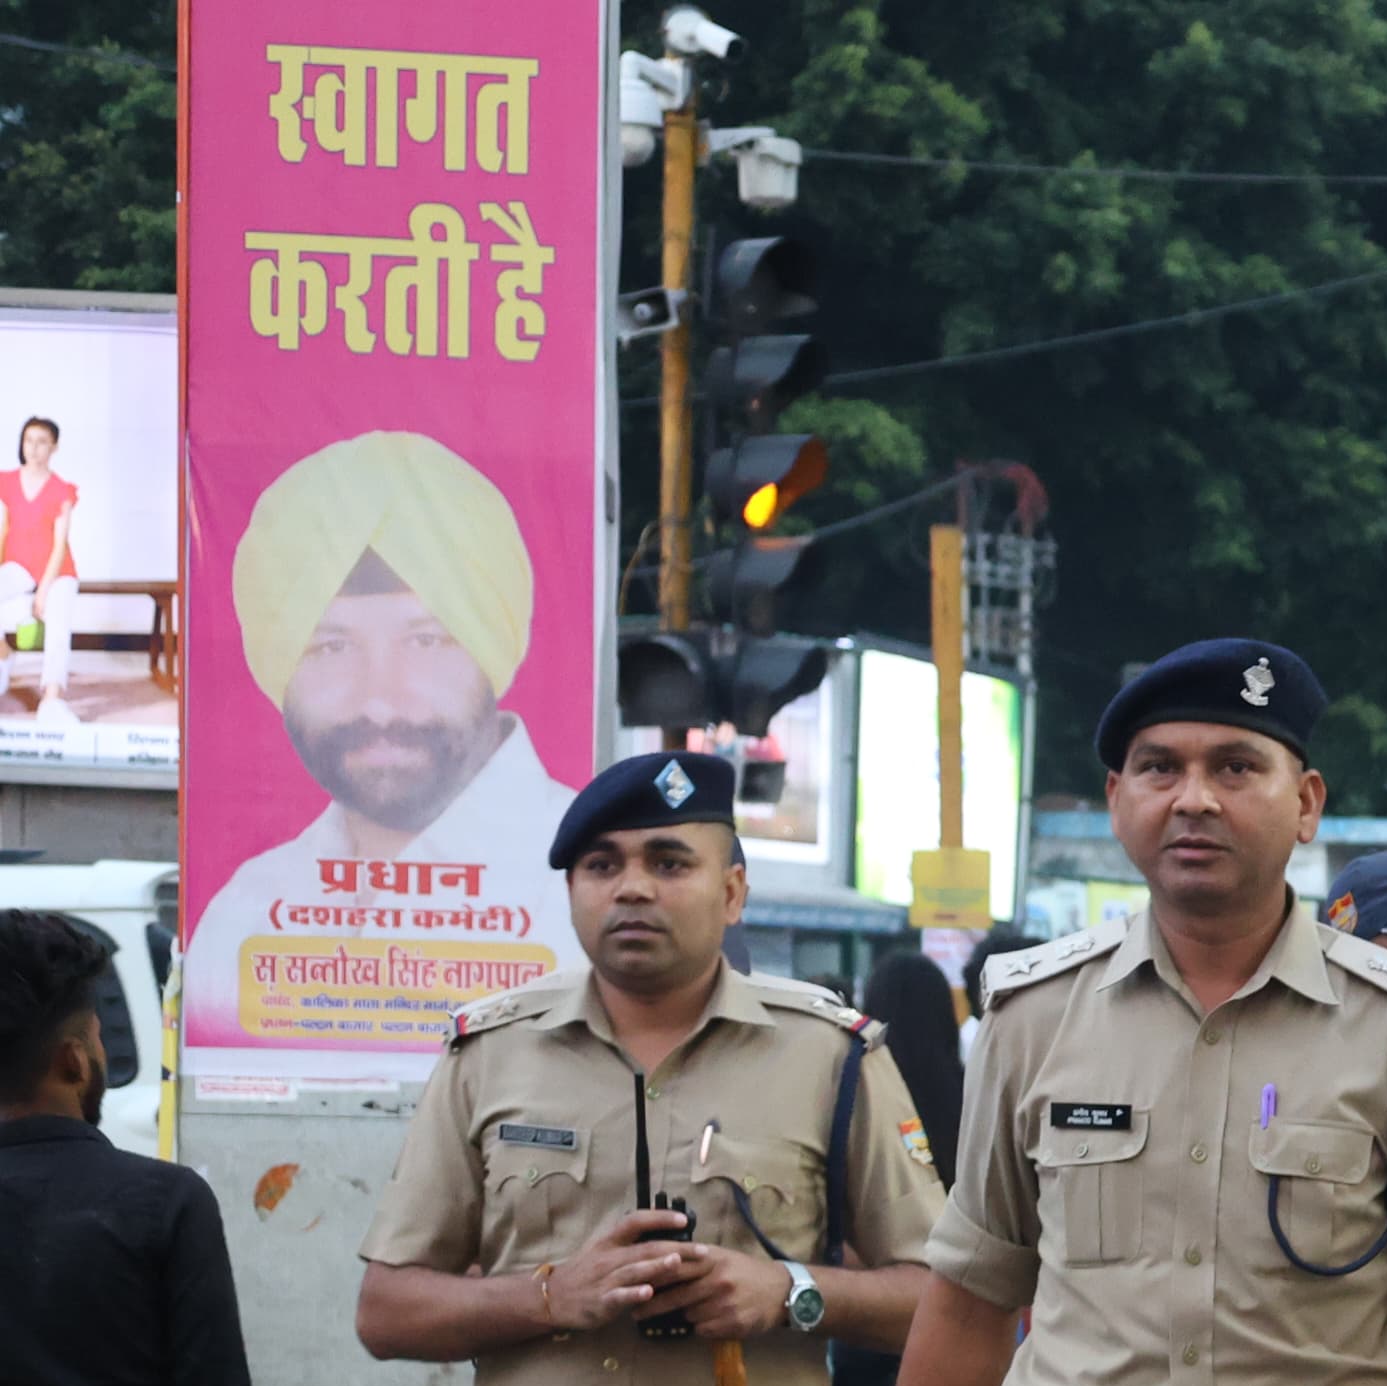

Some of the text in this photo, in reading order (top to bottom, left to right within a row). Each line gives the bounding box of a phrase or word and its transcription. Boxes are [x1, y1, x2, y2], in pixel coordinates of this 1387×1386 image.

[265, 43, 540, 176] स्वागत
[244, 201, 556, 363] करती है
[316, 857, 487, 897] प्रधान
[386, 945, 439, 989] सिंह
